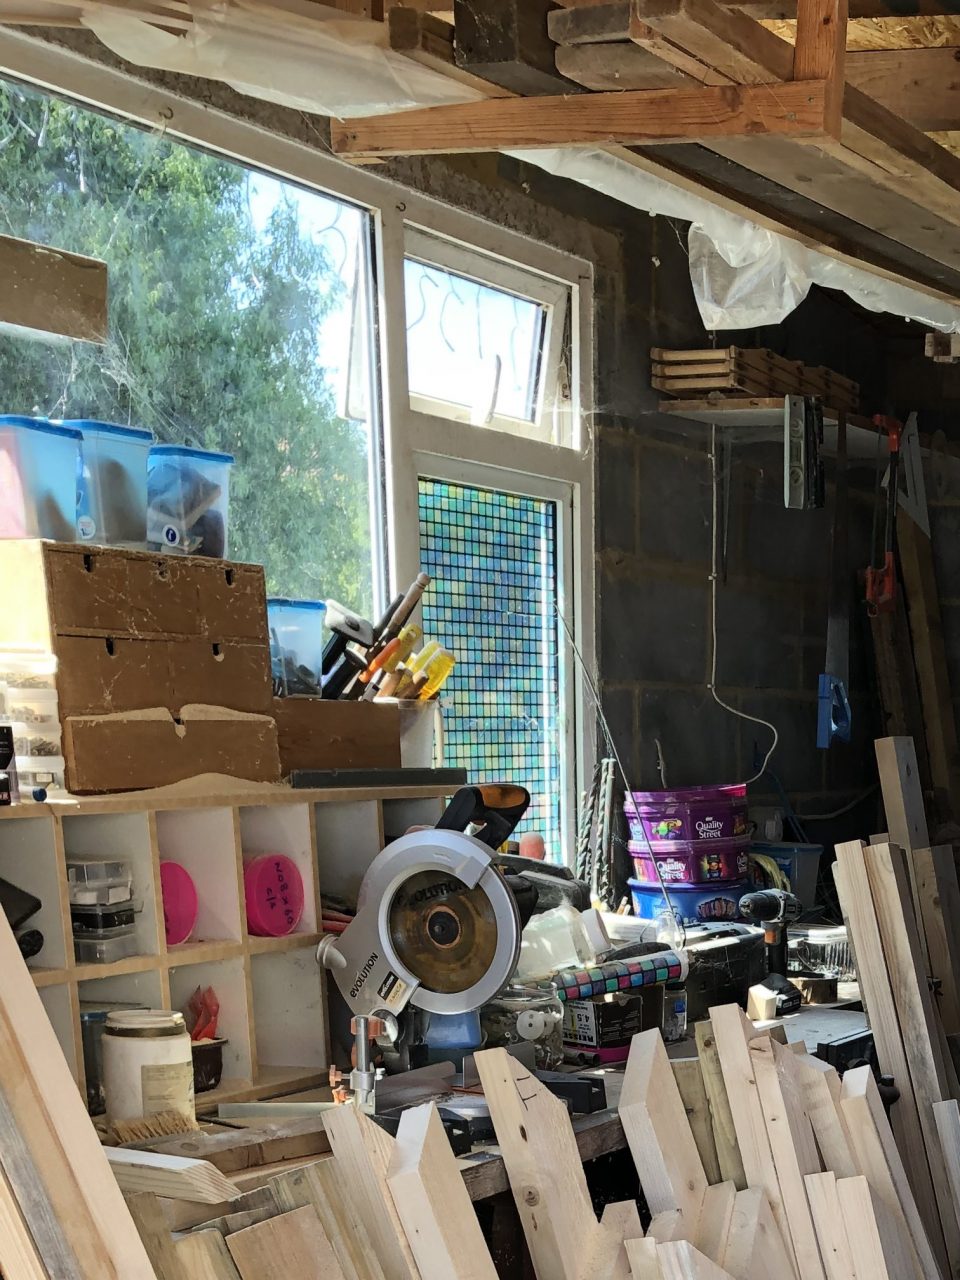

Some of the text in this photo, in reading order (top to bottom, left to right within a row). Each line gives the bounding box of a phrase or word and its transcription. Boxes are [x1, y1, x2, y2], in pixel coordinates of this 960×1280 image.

[695, 820, 724, 832] Quality
[698, 828, 722, 839] Street
[656, 861, 686, 872] Quality
[660, 870, 685, 880] Street
[576, 1013, 590, 1023] 4.5
